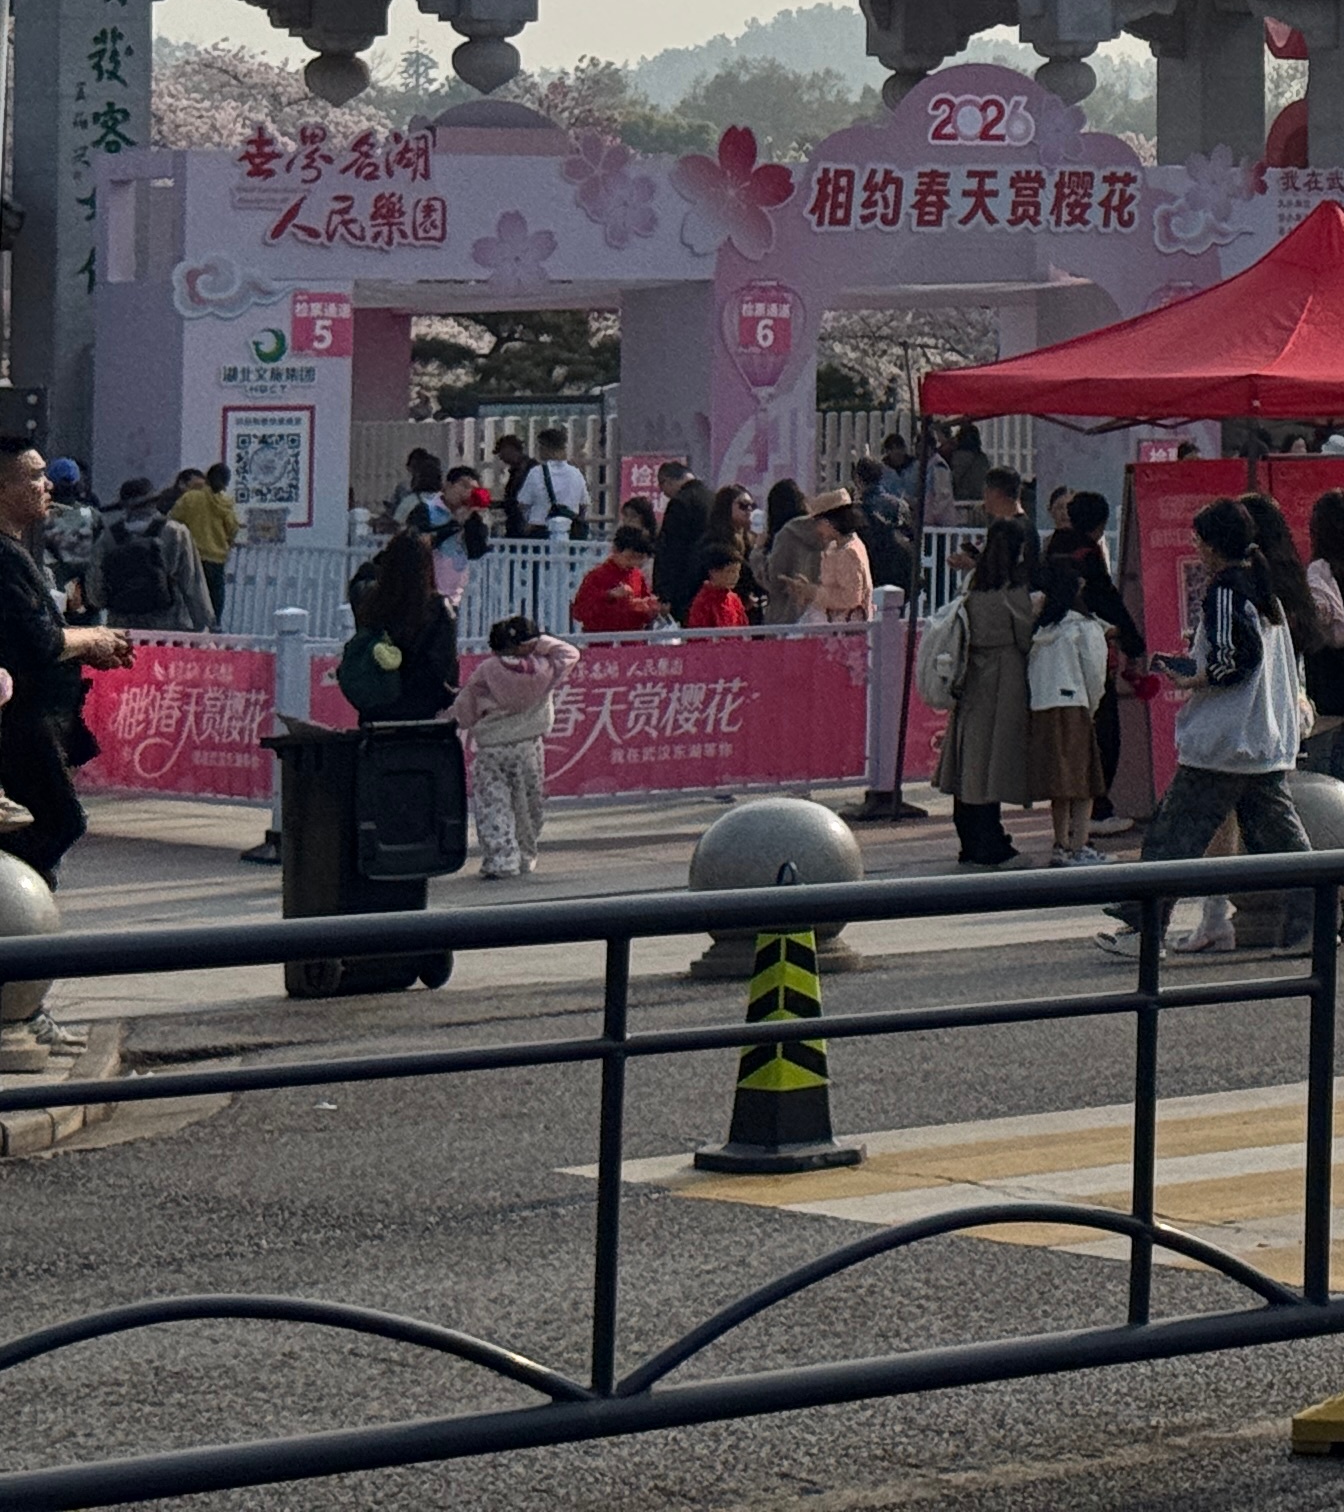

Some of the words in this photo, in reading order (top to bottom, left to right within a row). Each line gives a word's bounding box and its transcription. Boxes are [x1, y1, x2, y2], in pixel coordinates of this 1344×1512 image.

[930, 94, 1036, 144] 2026
[809, 167, 1138, 229] 相约春天赏樱花
[312, 319, 333, 348] 5
[756, 318, 775, 348] 6
